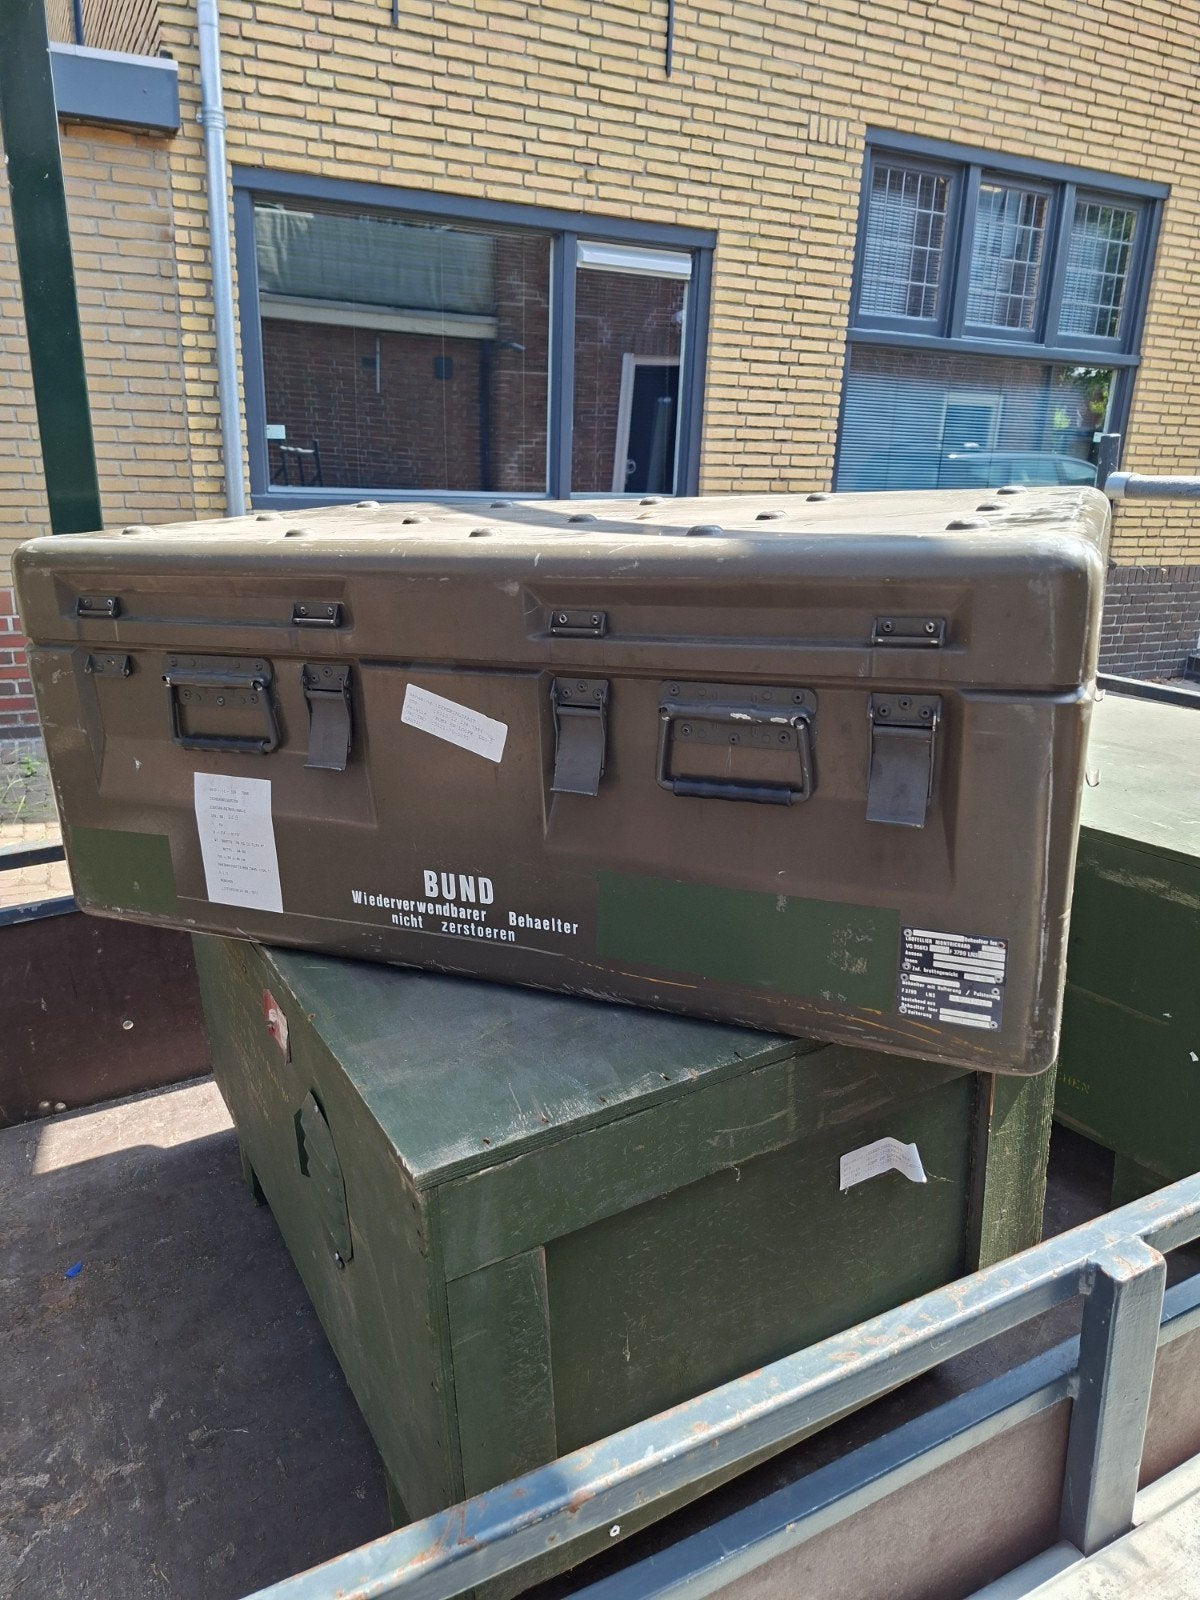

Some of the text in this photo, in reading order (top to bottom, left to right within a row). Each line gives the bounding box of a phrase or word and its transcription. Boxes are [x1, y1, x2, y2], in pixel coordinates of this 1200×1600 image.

[423, 869, 494, 905] BUND
[351, 889, 579, 935] Wiederverwendbarer Behaelter
[391, 913, 516, 942] nicht zerstoeren
